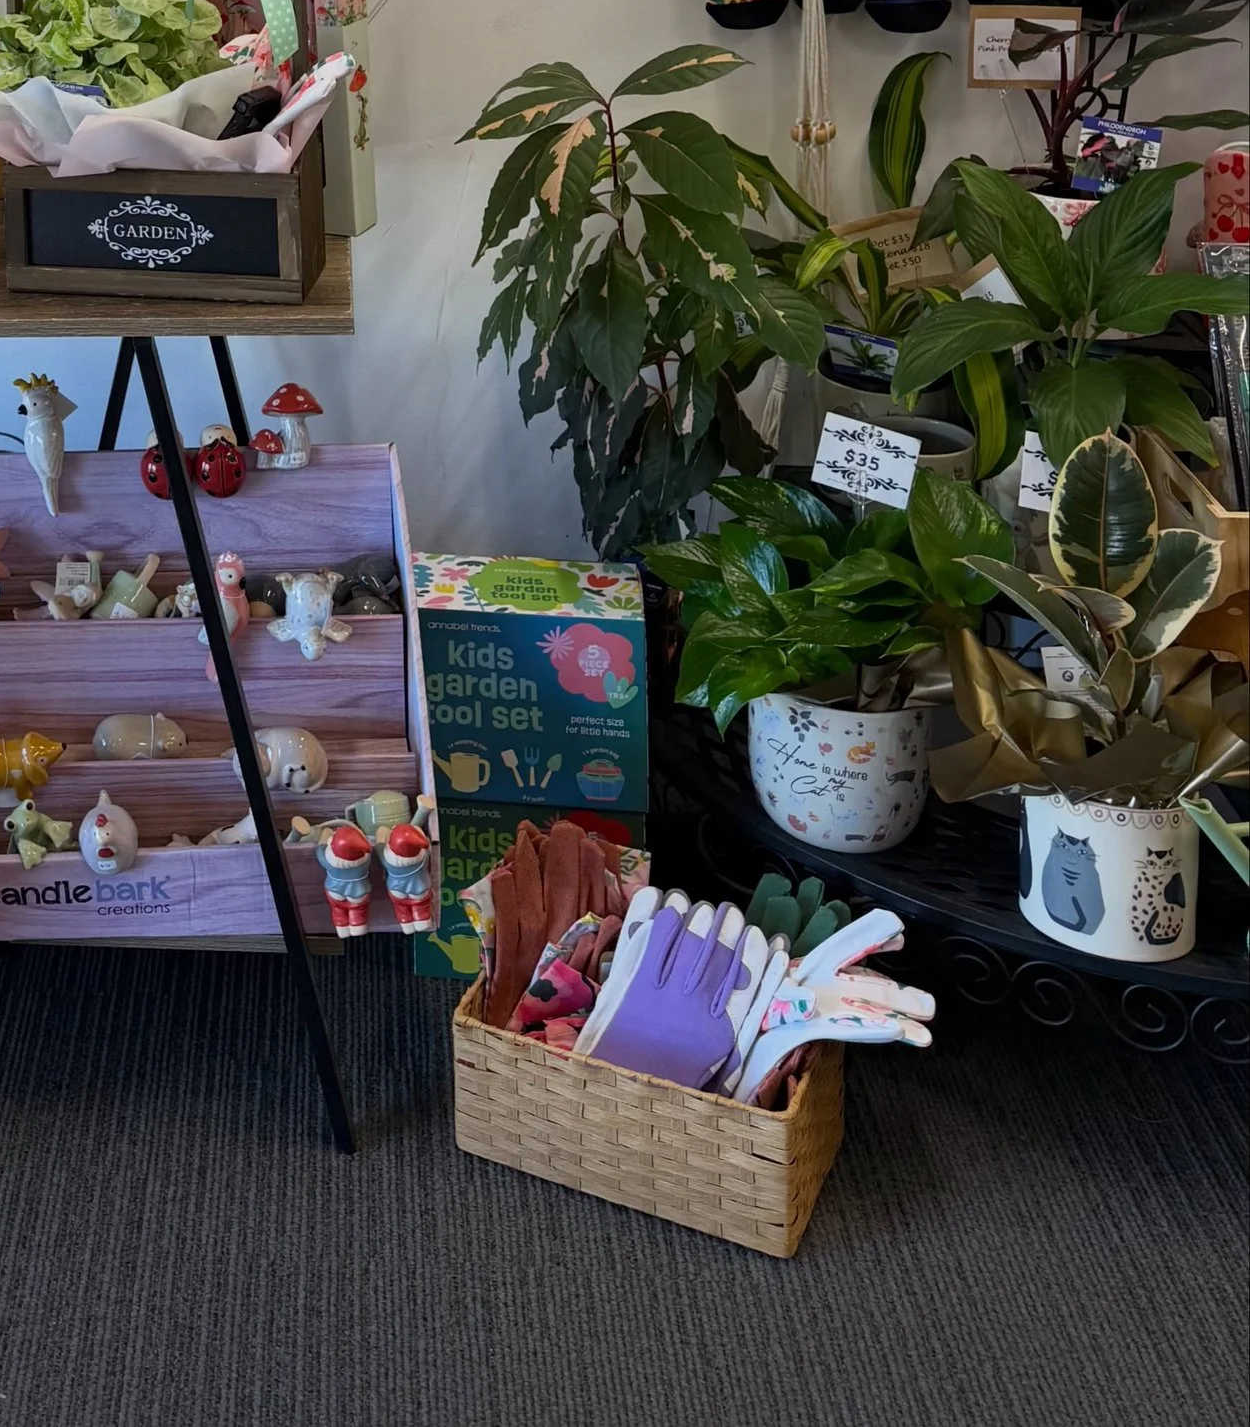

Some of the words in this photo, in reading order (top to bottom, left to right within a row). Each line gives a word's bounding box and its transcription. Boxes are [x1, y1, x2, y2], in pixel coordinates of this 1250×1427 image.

[1097, 120, 1147, 135] PHILODENDRON
[114, 224, 188, 240] GARDEN
[892, 233, 911, 245] $35
[902, 255, 922, 267] $50
[843, 448, 880, 471] $35
[506, 575, 544, 586] kids
[493, 583, 558, 594] garden
[491, 590, 526, 601] tool
[531, 593, 561, 602] set
[427, 620, 469, 631] annabel
[448, 640, 514, 670] kids
[587, 644, 599, 659] 5
[578, 659, 610, 670] PIECE
[584, 668, 604, 677] SET
[426, 671, 538, 702] garden
[492, 704, 544, 732] set
[570, 715, 605, 727] perfect
[606, 717, 625, 727] size
[565, 725, 578, 735] for
[580, 726, 601, 736] little
[603, 727, 631, 738] hands
[767, 738, 817, 770] Home
[821, 763, 831, 774] is
[834, 766, 868, 781] where
[790, 775, 831, 797] Cat
[836, 790, 845, 802] is
[828, 777, 854, 791] my
[438, 808, 470, 817] nnabel
[450, 824, 515, 854] kids
[97, 902, 171, 916] creations
